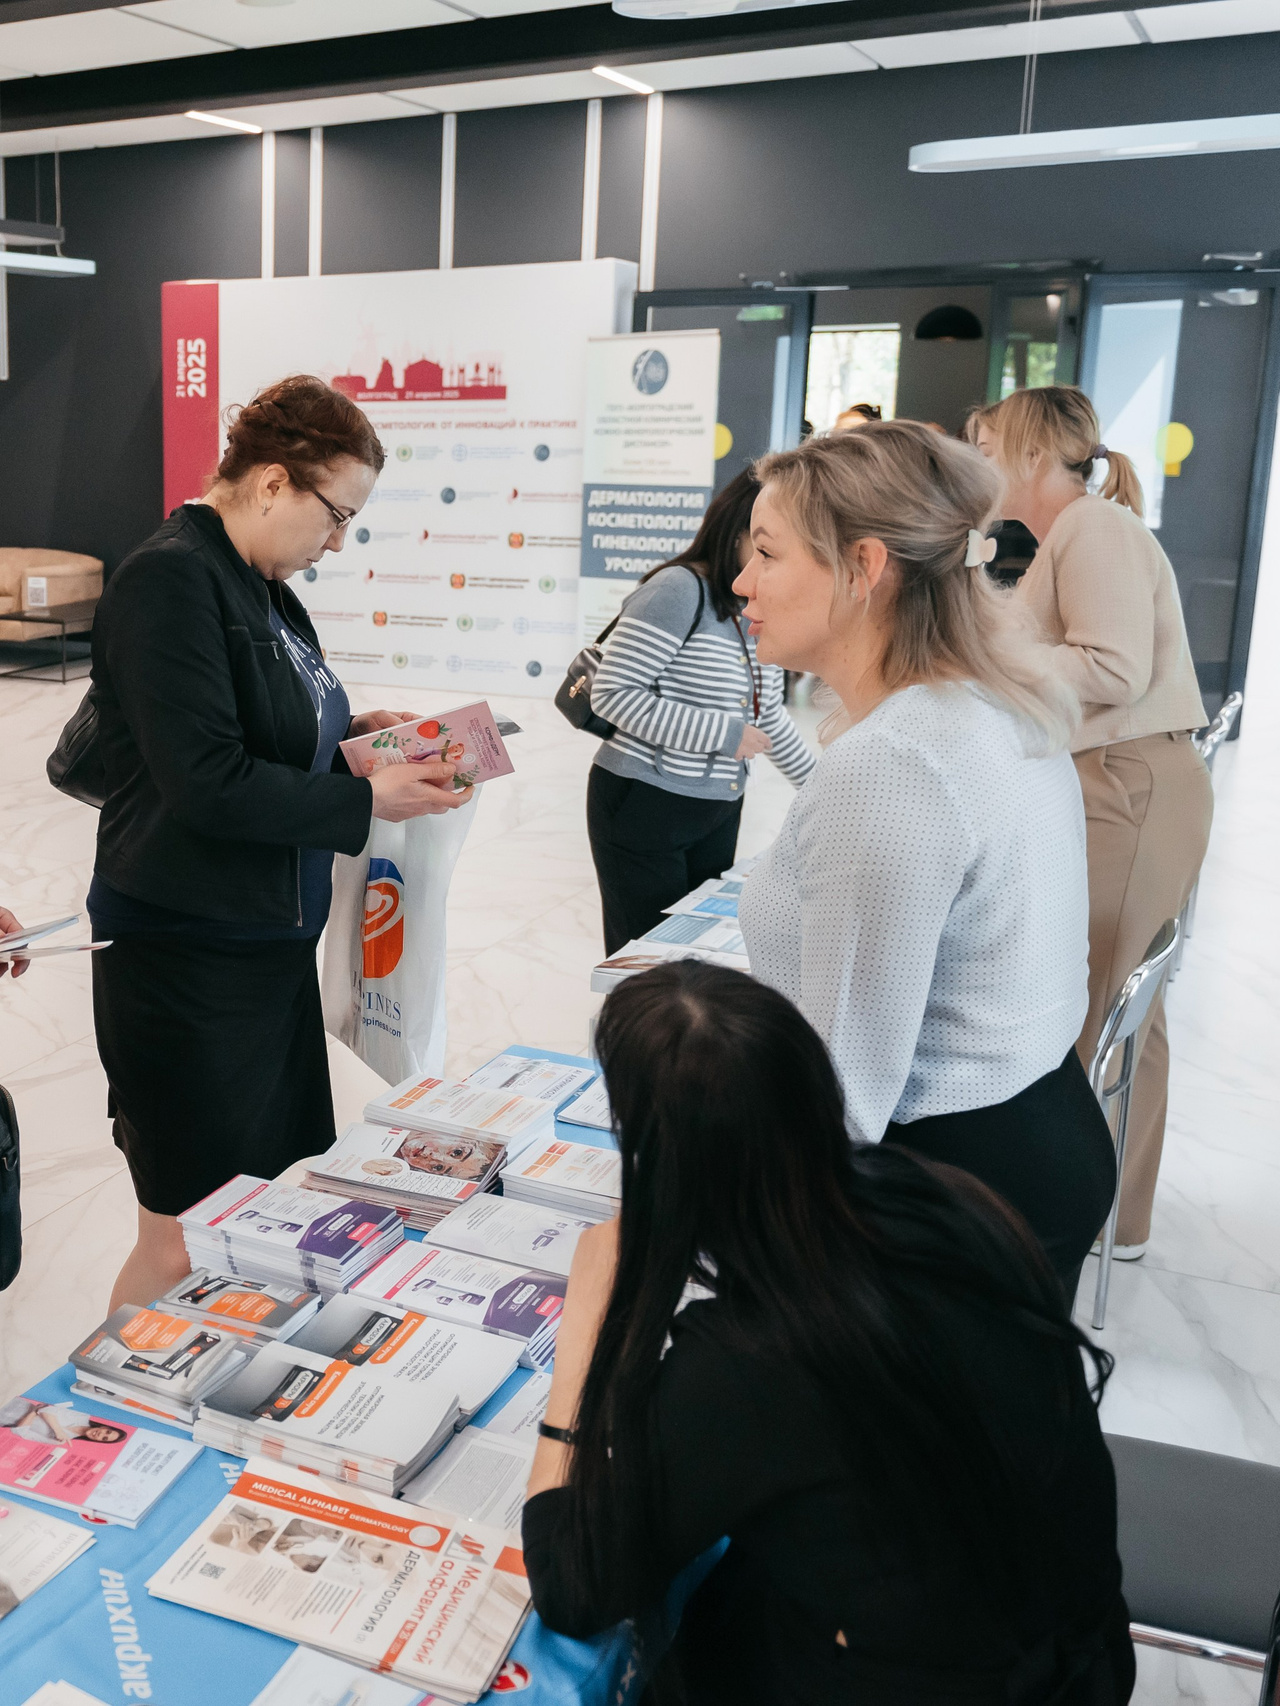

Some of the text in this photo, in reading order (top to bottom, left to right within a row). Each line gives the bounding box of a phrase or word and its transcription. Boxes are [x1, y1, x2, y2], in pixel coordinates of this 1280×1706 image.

[187, 338, 207, 398] 2025
[175, 385, 186, 398] 21
[455, 417, 517, 430] ИННОВАЦИЙ
[527, 420, 577, 429] ПРАКТИКЕ
[588, 490, 705, 509] ДЕРМАТОЛОГИЯ
[587, 513, 704, 532] КОСМЕТОЛОГИЯ
[604, 557, 660, 573] УРОЛО
[363, 1319, 390, 1344] АКРИДЕРМ
[284, 1372, 310, 1398] АКРИДЕРМ
[251, 1481, 409, 1535] MEDICAL ALPHABET DERMATOLOGY
[359, 1550, 420, 1633] ДЕРМАТОЛОГИЯ
[409, 1558, 455, 1619] алфавит
[411, 1564, 482, 1666] Медицинский
[99, 1567, 153, 1699] акрихин
